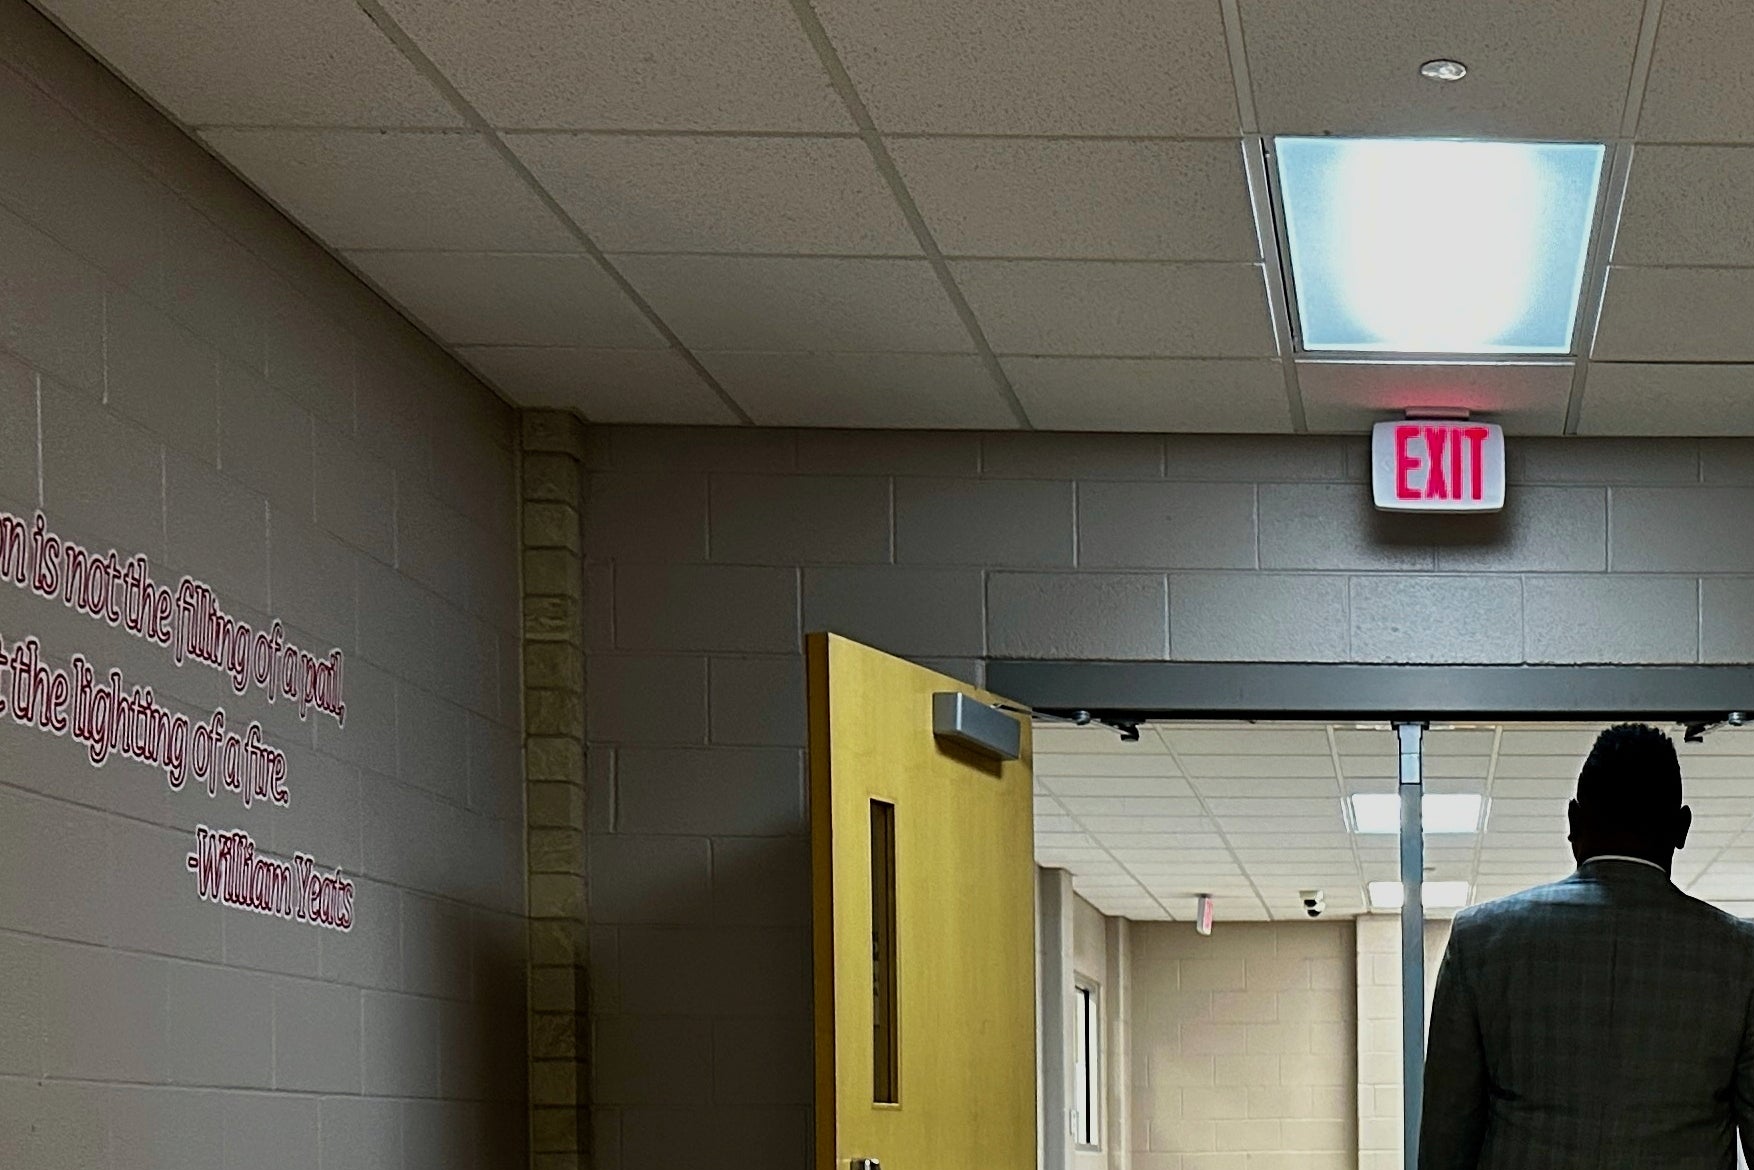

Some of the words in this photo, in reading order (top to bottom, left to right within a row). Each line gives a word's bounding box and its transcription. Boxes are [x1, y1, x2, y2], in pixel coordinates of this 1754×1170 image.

[1395, 426, 1490, 501] EXIT
[32, 509, 61, 597] is
[64, 541, 123, 627] not
[122, 553, 176, 648] the
[175, 575, 250, 696] filling
[254, 618, 284, 704] of
[281, 643, 300, 700] a
[299, 648, 346, 728] pail,
[10, 634, 71, 736] the
[71, 655, 189, 792] lighting
[193, 707, 226, 798] of
[222, 731, 243, 793] a
[242, 720, 290, 808] fire.
[187, 823, 292, 919] -William
[293, 850, 356, 930] Yeats
